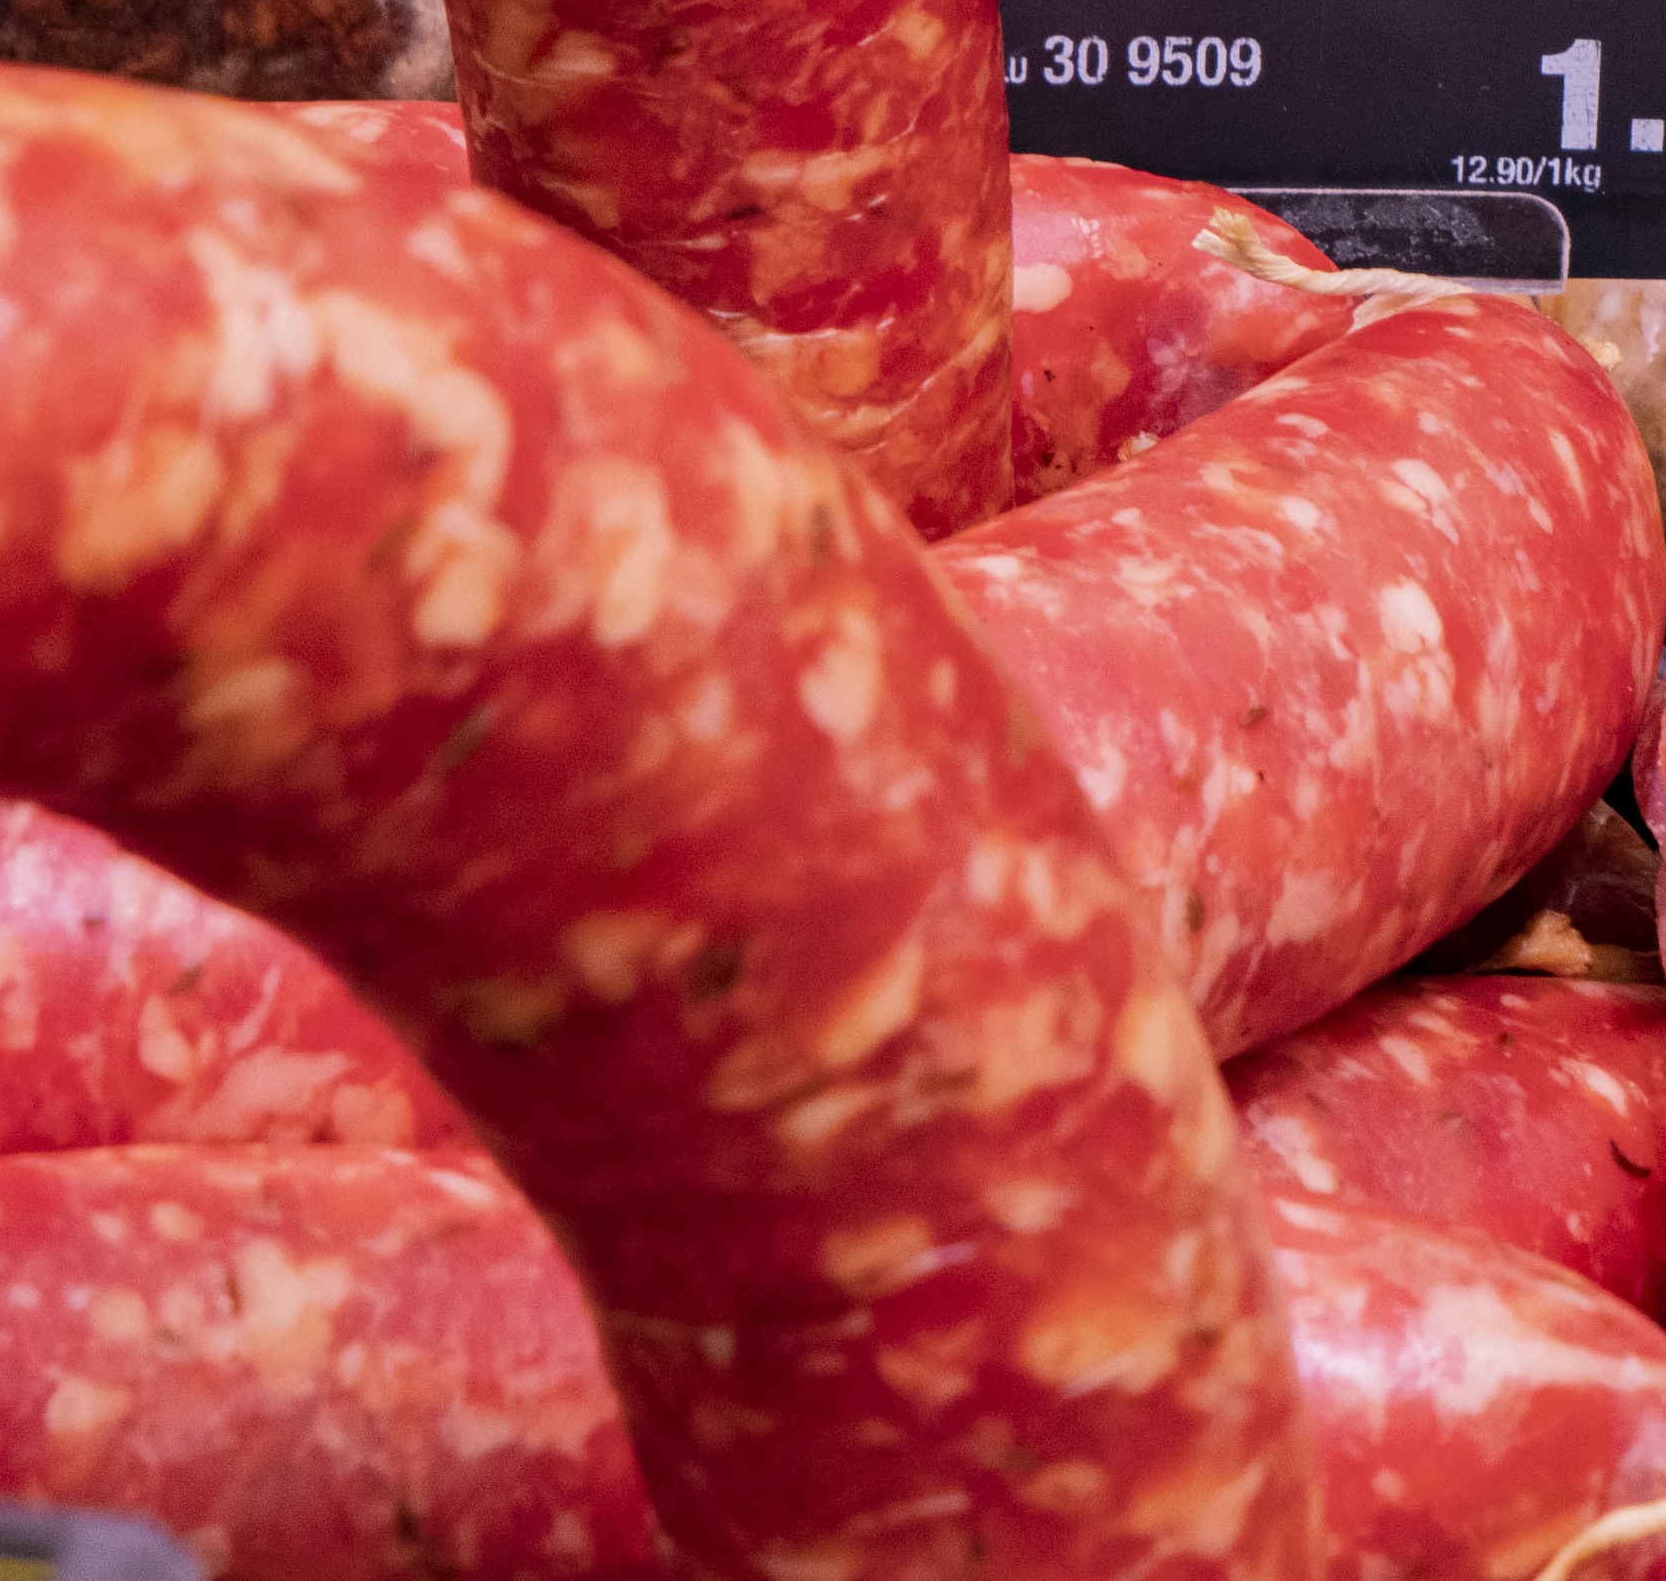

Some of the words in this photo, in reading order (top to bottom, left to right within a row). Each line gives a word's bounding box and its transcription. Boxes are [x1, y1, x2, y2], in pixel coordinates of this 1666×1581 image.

[1043, 35, 1109, 85] 30
[1127, 35, 1262, 87] 9509
[1451, 155, 1602, 194] 12.90/1kg
